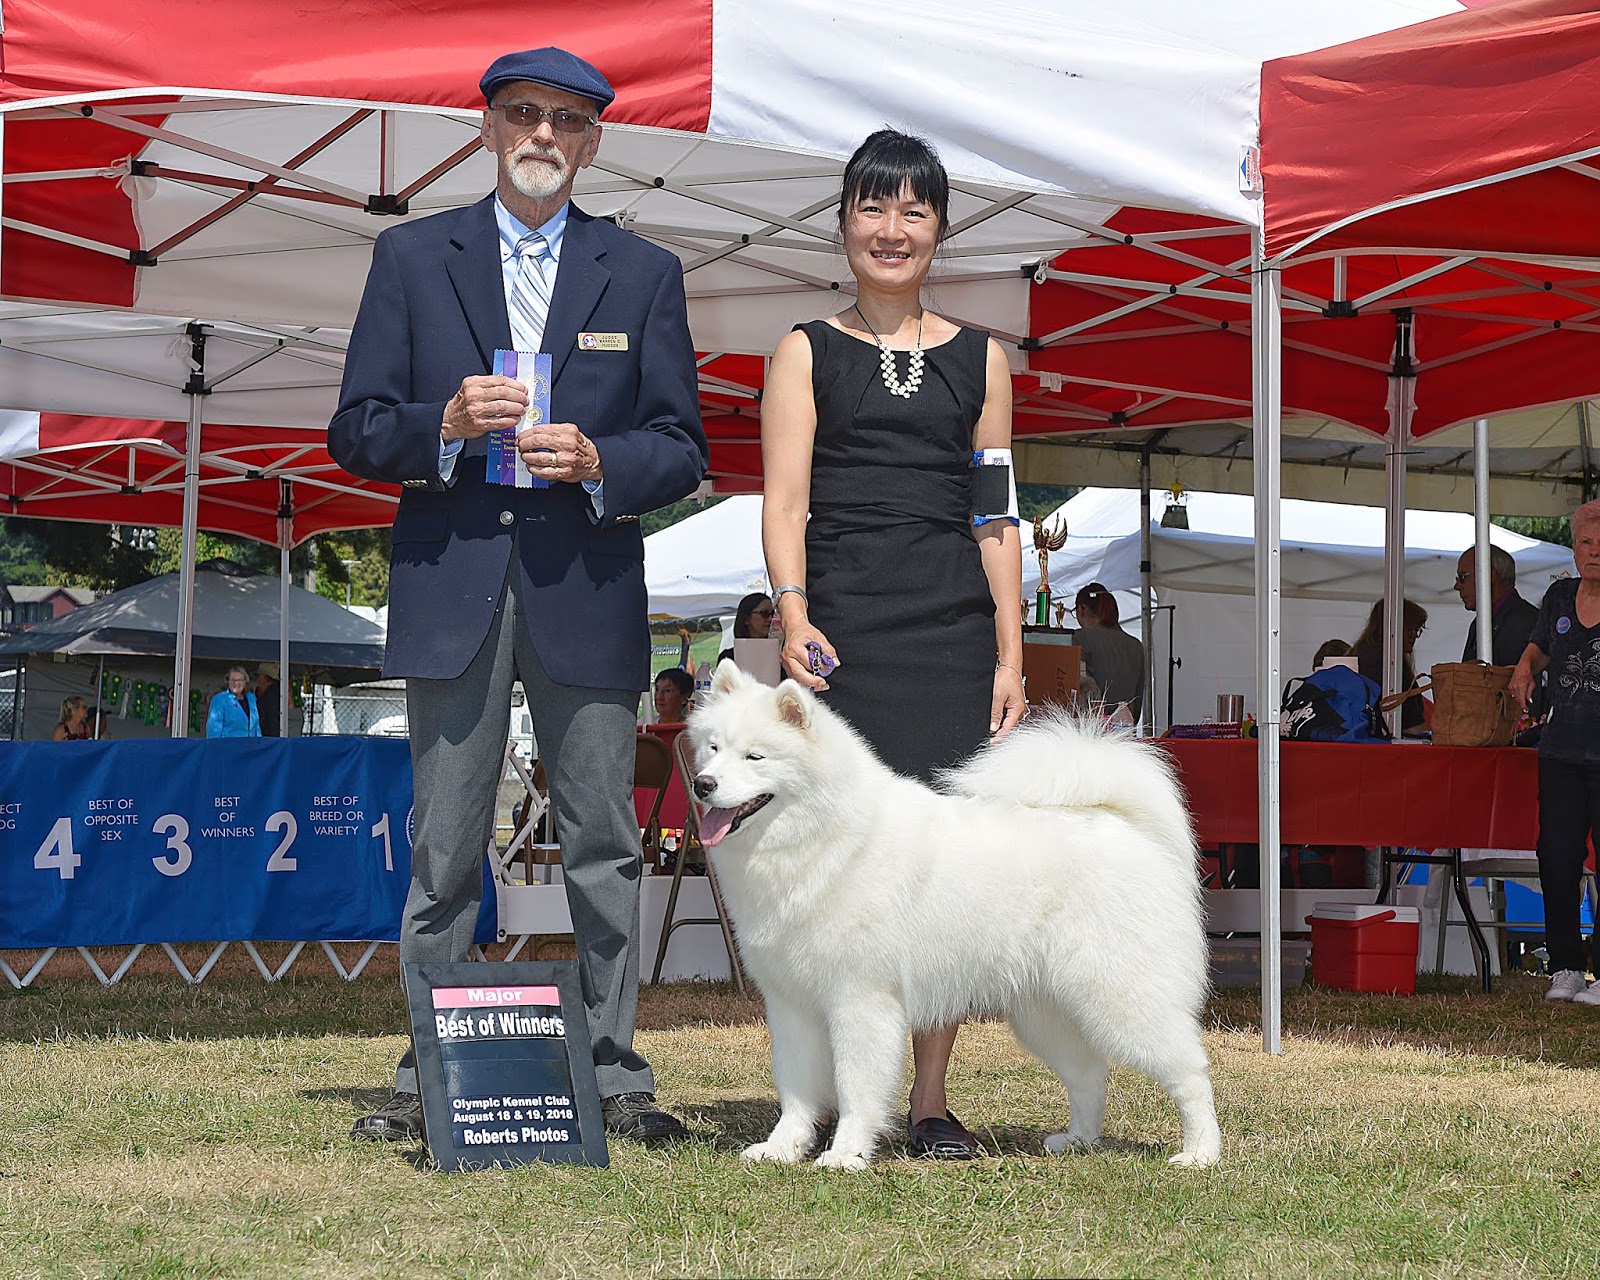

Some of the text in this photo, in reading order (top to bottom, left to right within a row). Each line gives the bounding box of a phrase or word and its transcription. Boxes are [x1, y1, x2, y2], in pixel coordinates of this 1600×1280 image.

[88, 799, 134, 811] BEST OF
[214, 797, 240, 807] BEST
[313, 796, 359, 806] BEST OF
[84, 815, 139, 826] OPPOSITE
[219, 812, 236, 823] OF
[309, 811, 364, 821] BREED OR
[101, 830, 122, 841] SEX
[201, 827, 255, 838] WINNERS
[314, 826, 359, 836] VARIETY
[152, 813, 193, 877] 3
[265, 810, 298, 872] 2
[371, 812, 394, 872] 1
[33, 817, 82, 880] 4
[467, 989, 523, 1004] Major
[435, 1012, 565, 1038] Best of Winners
[452, 1095, 570, 1111] Olympic Kennel Club
[452, 1108, 574, 1124] August 18 & 19, 2018
[463, 1126, 569, 1145] Roberts Photos
